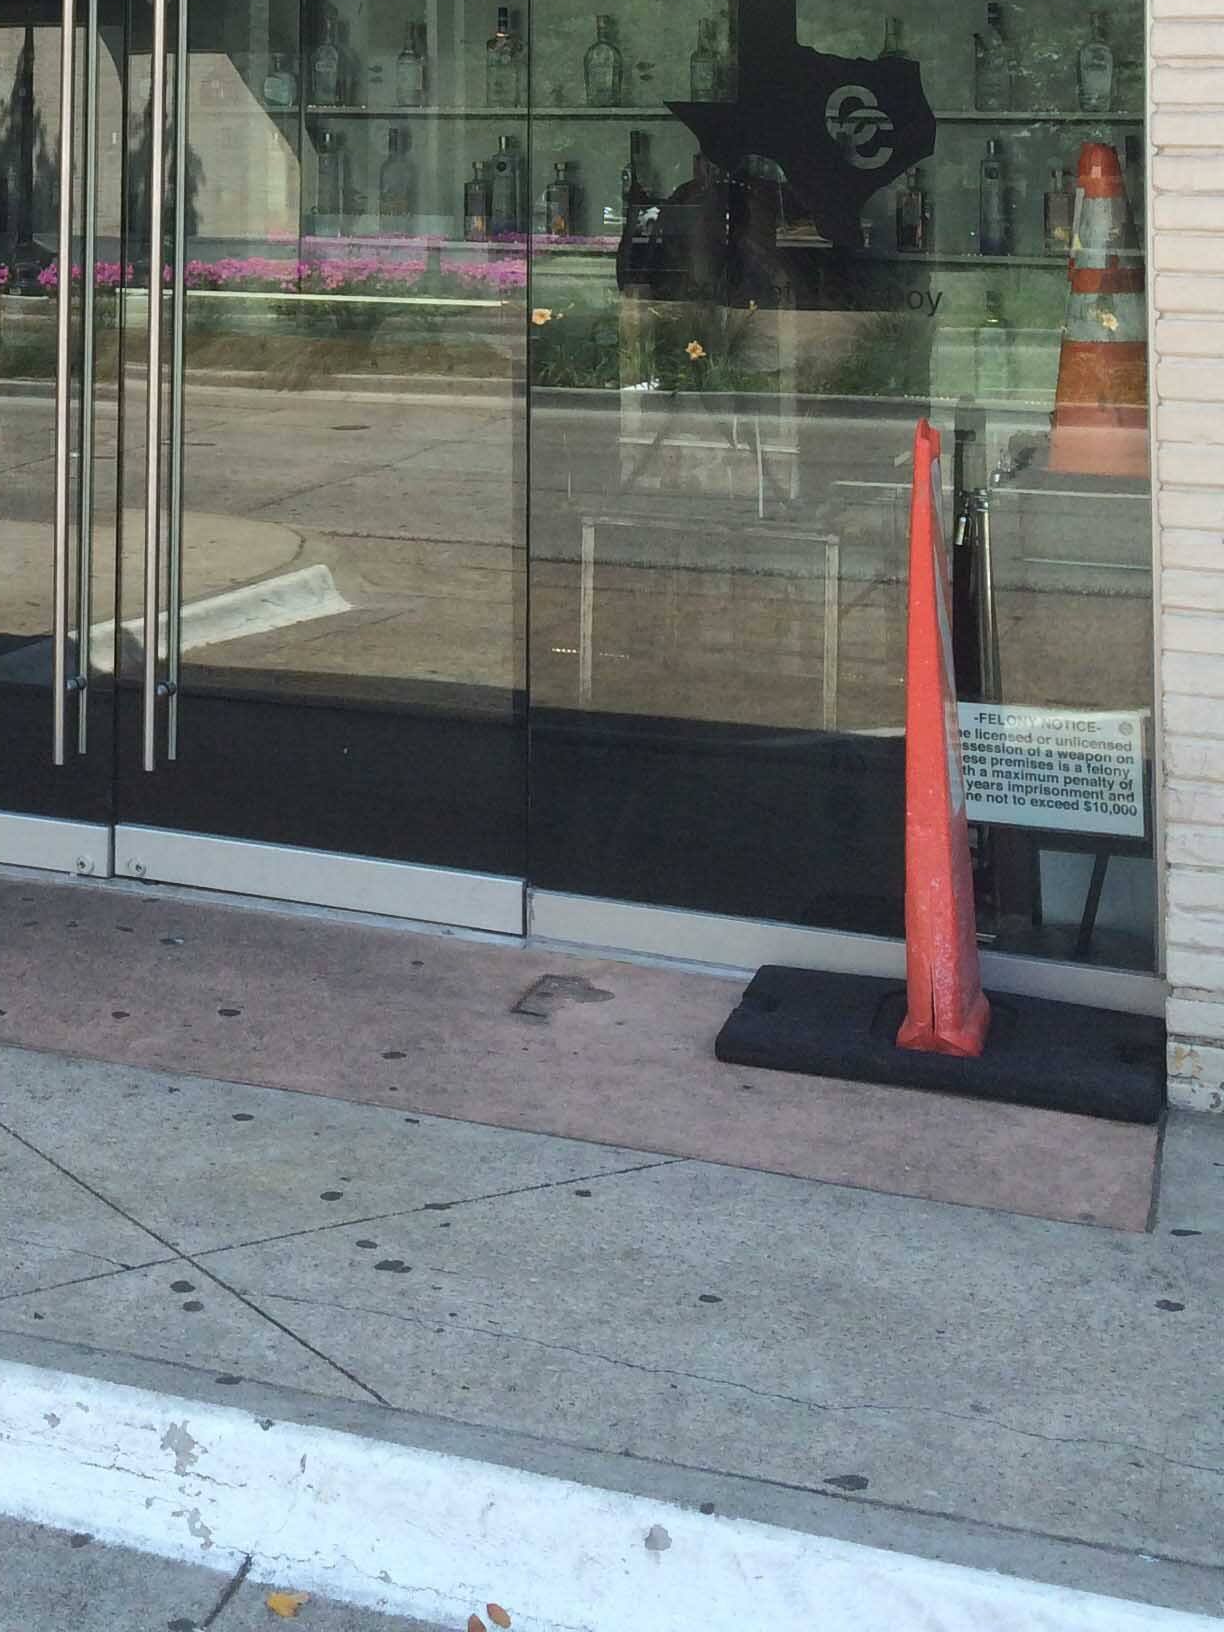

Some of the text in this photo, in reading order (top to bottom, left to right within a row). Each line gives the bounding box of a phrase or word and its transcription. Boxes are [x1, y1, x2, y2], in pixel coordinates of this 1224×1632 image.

[975, 728, 1033, 743] licensed
[1037, 736, 1051, 745] or
[1055, 735, 1132, 752] unlicensed
[962, 742, 1134, 764] ssession of a weapon on
[962, 754, 1130, 780] ese premises is a felony
[966, 779, 1134, 803] years imprisonment and
[979, 768, 988, 777] a
[992, 769, 1059, 784] maximum
[1063, 776, 1114, 791] penalty
[1119, 779, 1133, 790] of
[986, 793, 1008, 804] not
[1012, 795, 1026, 806] to
[1030, 798, 1079, 811] exceed
[1083, 801, 1138, 817] $10,000
